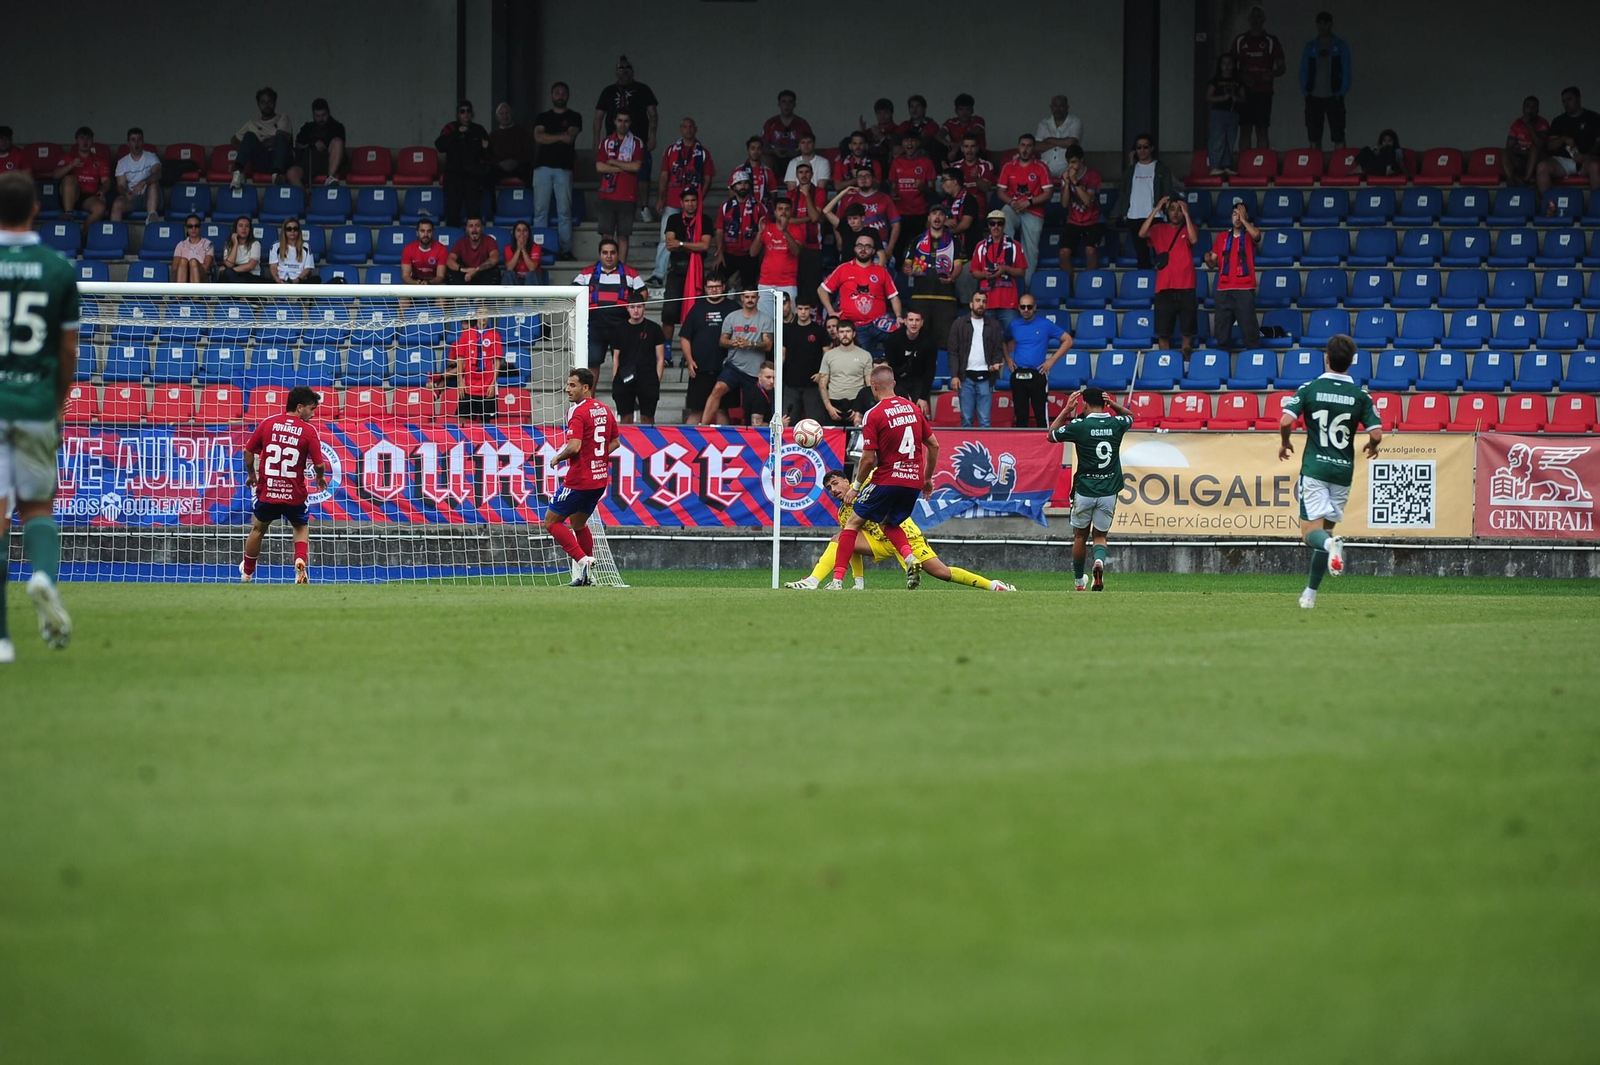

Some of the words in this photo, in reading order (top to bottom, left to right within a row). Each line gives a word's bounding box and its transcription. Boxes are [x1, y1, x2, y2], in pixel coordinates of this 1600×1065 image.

[1316, 392, 1355, 406] NAVARRO
[884, 404, 914, 418] POVARELO
[272, 423, 303, 436] POVARELO
[888, 414, 918, 429] LABRADA
[1311, 409, 1352, 450] 16
[593, 425, 606, 457] 5
[898, 425, 916, 459] 4
[1090, 428, 1113, 437] OSAMA
[1095, 441, 1113, 469] 9
[1376, 446, 1437, 455] ww.solgaleo.es
[56, 436, 103, 490] VE
[113, 436, 236, 490] AURIA
[265, 444, 300, 478] 22
[1118, 472, 1299, 508] SOLGALE
[52, 498, 100, 516] EIROS
[122, 497, 202, 516] OURENSE
[780, 497, 811, 508] URENSE
[1117, 511, 1301, 530] #AEnerxíadeOUREN
[1489, 508, 1594, 532] GENERALI
